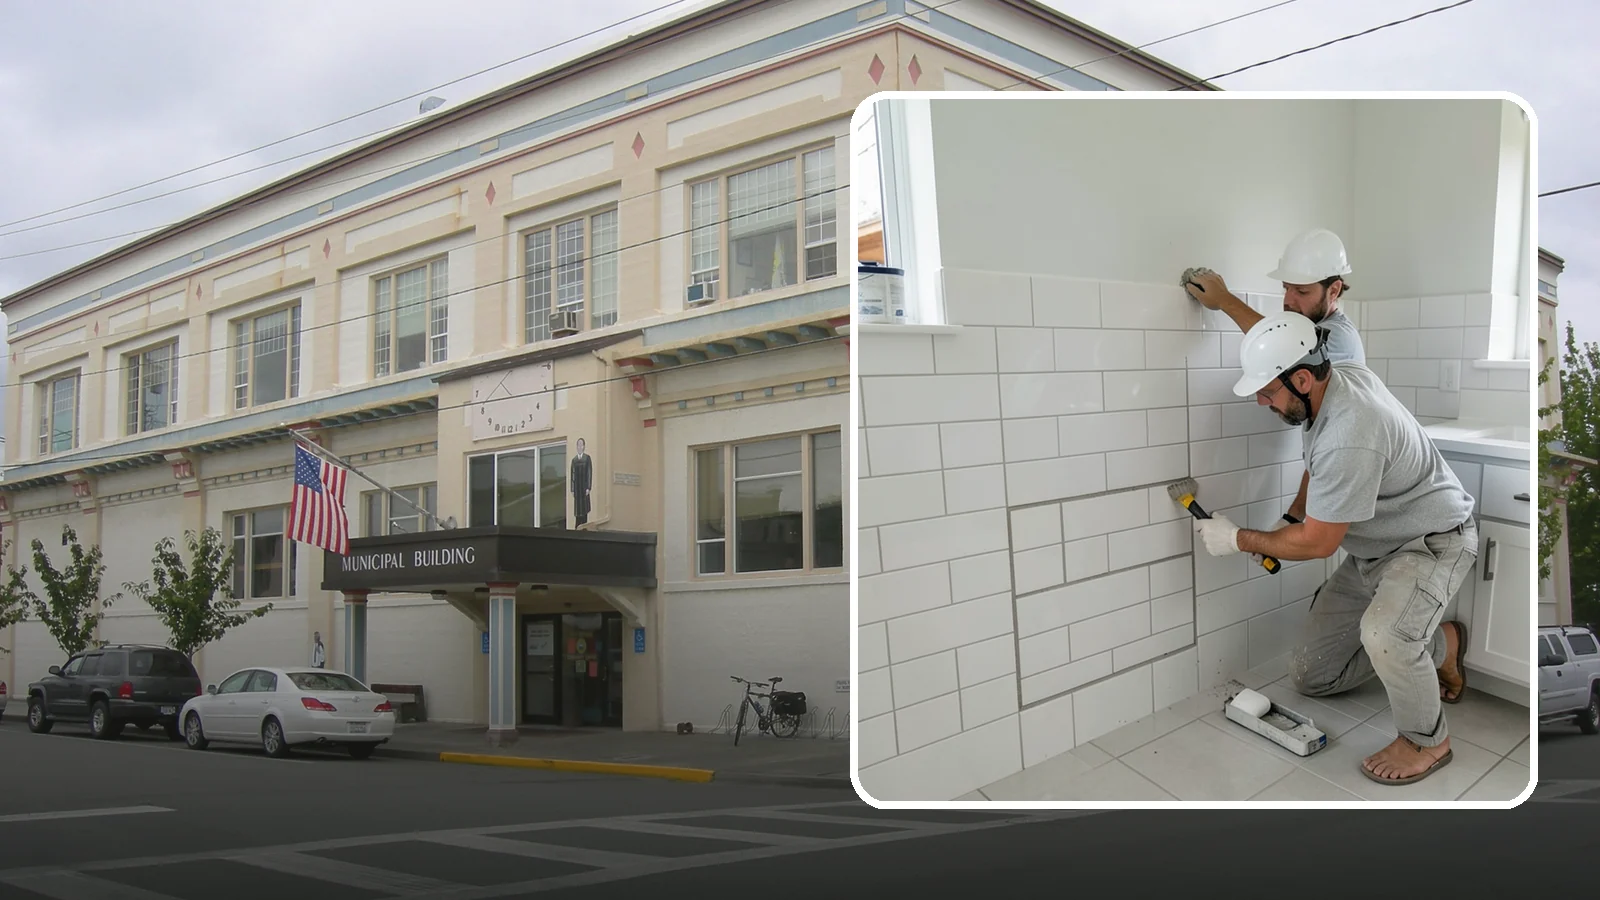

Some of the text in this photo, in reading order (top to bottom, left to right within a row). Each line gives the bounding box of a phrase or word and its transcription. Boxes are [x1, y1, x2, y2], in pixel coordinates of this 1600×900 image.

[536, 402, 540, 410] 4
[488, 418, 492, 426] 9
[528, 414, 532, 422] 3
[494, 424, 500, 432] 10
[521, 420, 526, 428] 2
[342, 546, 475, 572] MUNICIPAL BUILDING
